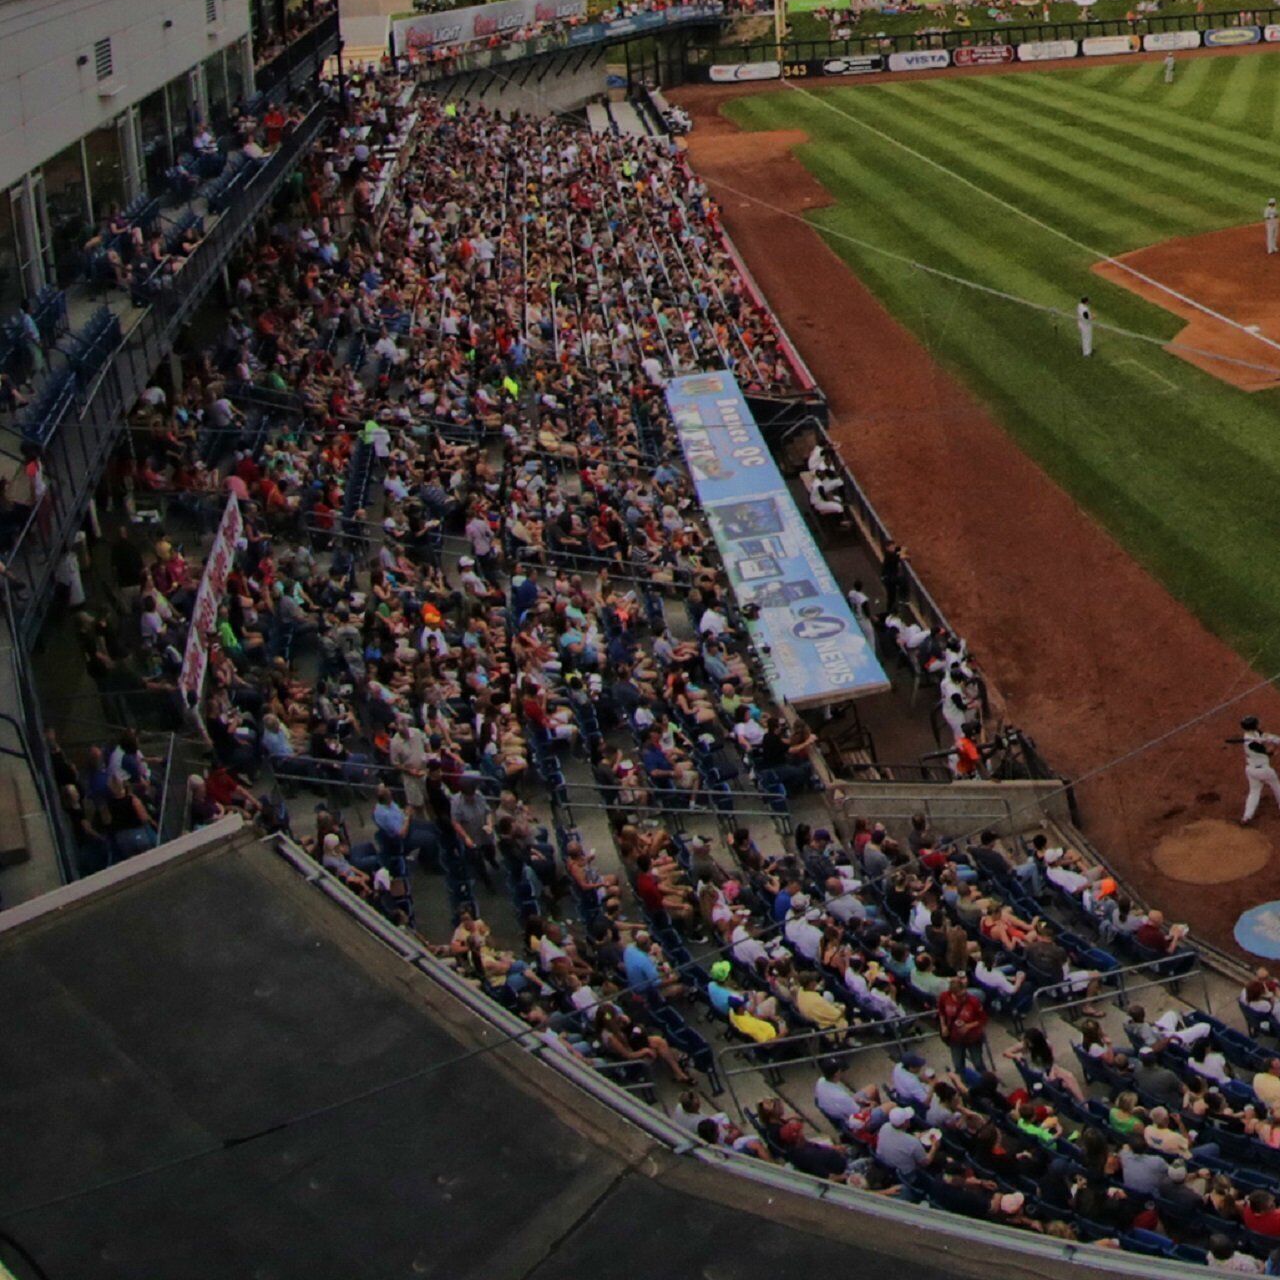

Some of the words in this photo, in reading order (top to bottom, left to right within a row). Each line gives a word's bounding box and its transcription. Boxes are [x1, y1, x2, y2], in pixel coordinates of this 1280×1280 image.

[556, 3, 582, 16] LIGHT
[498, 14, 524, 29] LIGHT
[434, 25, 462, 42] LIGHT
[904, 54, 947, 65] VISTA
[783, 65, 807, 77] 343
[814, 639, 855, 685] NEWS
